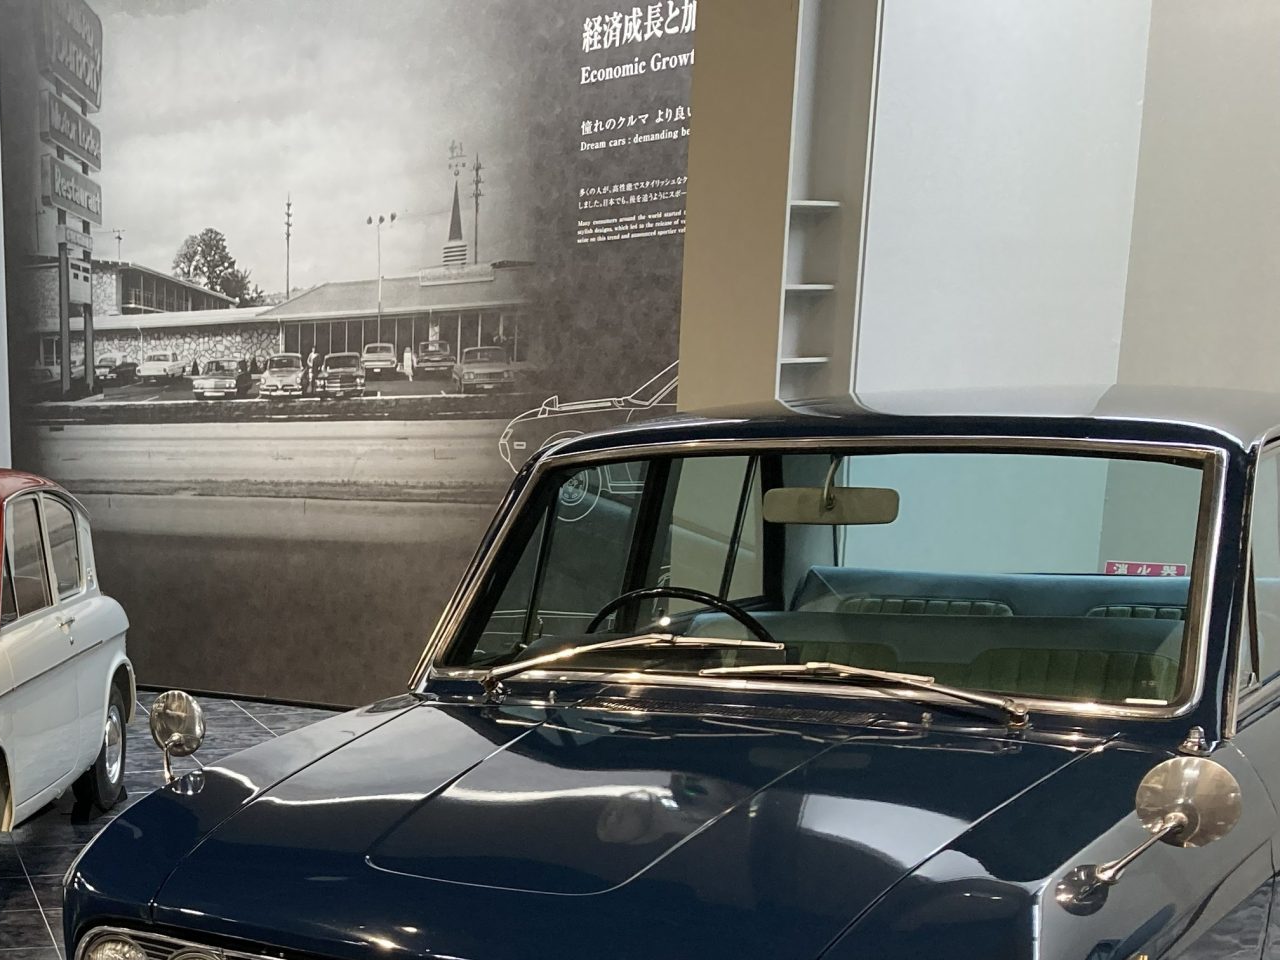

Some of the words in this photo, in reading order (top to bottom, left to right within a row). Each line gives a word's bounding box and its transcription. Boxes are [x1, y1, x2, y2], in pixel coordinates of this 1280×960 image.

[580, 57, 646, 84] Economic
[581, 114, 649, 135] 憧れのクルマ
[580, 141, 606, 151] Dream
[609, 138, 626, 147] cars
[633, 130, 678, 144] demanding
[55, 164, 101, 215] Restaurant
